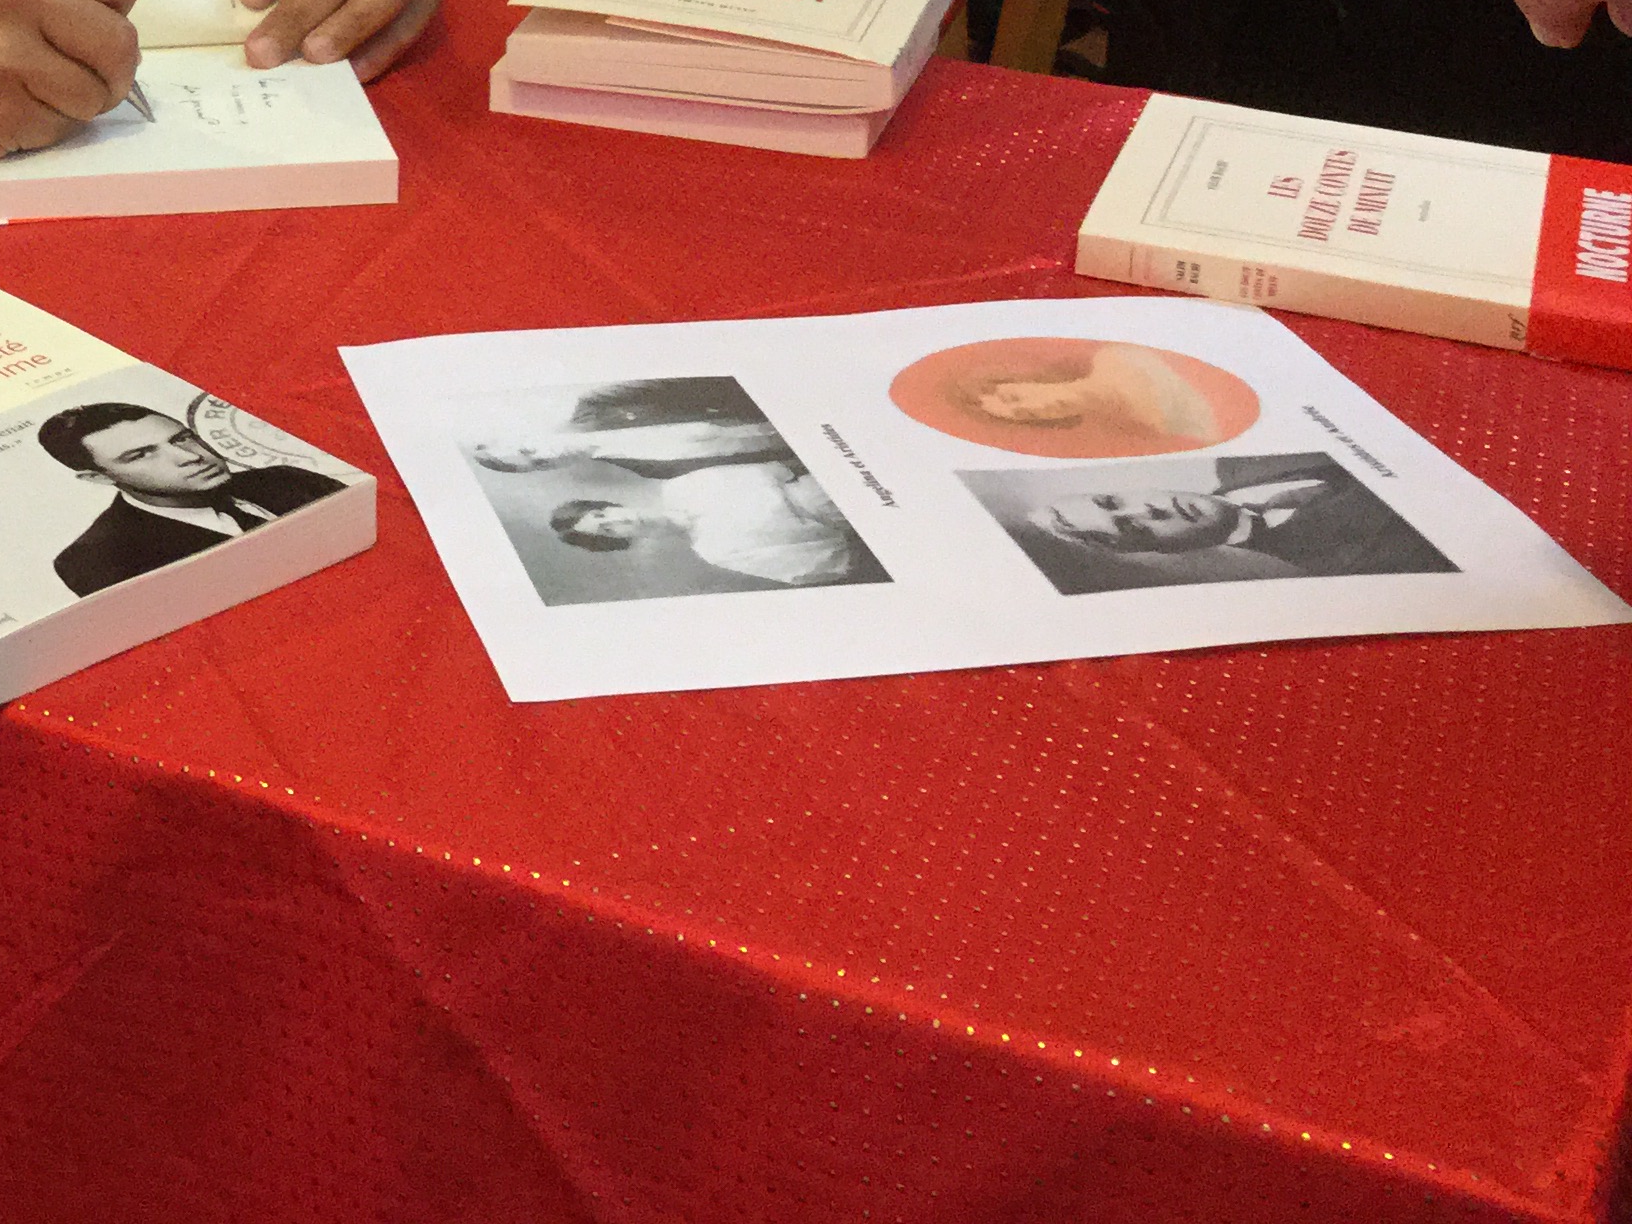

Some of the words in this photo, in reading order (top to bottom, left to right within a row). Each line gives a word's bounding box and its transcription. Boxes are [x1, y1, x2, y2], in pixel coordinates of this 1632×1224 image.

[1267, 175, 1304, 199] LES
[1314, 148, 1359, 197] CONTES
[1354, 168, 1396, 213] MINUIT
[1297, 197, 1341, 241] DOUZE
[1347, 217, 1383, 236] DE
[1575, 187, 1632, 283] NOCTURNE
